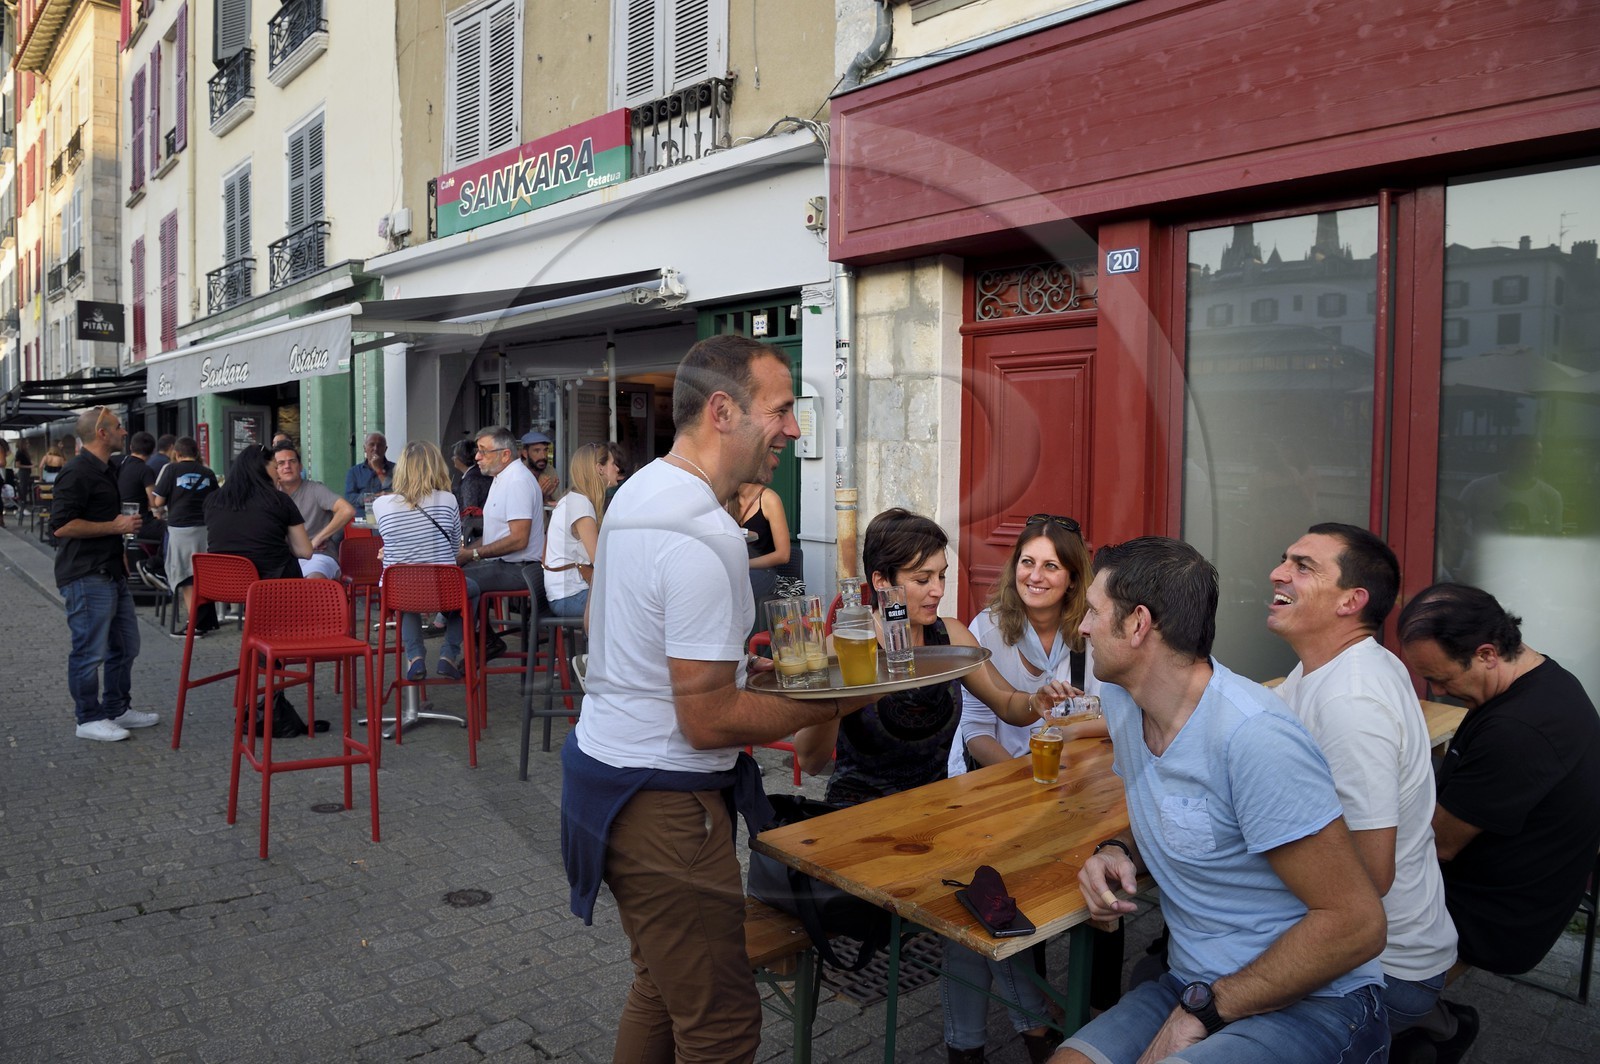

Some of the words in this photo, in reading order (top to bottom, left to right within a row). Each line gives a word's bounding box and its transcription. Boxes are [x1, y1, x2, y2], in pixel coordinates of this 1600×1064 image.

[441, 177, 455, 190] Café
[458, 136, 595, 217] SANKARA
[587, 171, 621, 188] Ostatua
[1113, 252, 1132, 270] 20
[200, 353, 249, 389] Sankara
[289, 343, 329, 374] Ostatua
